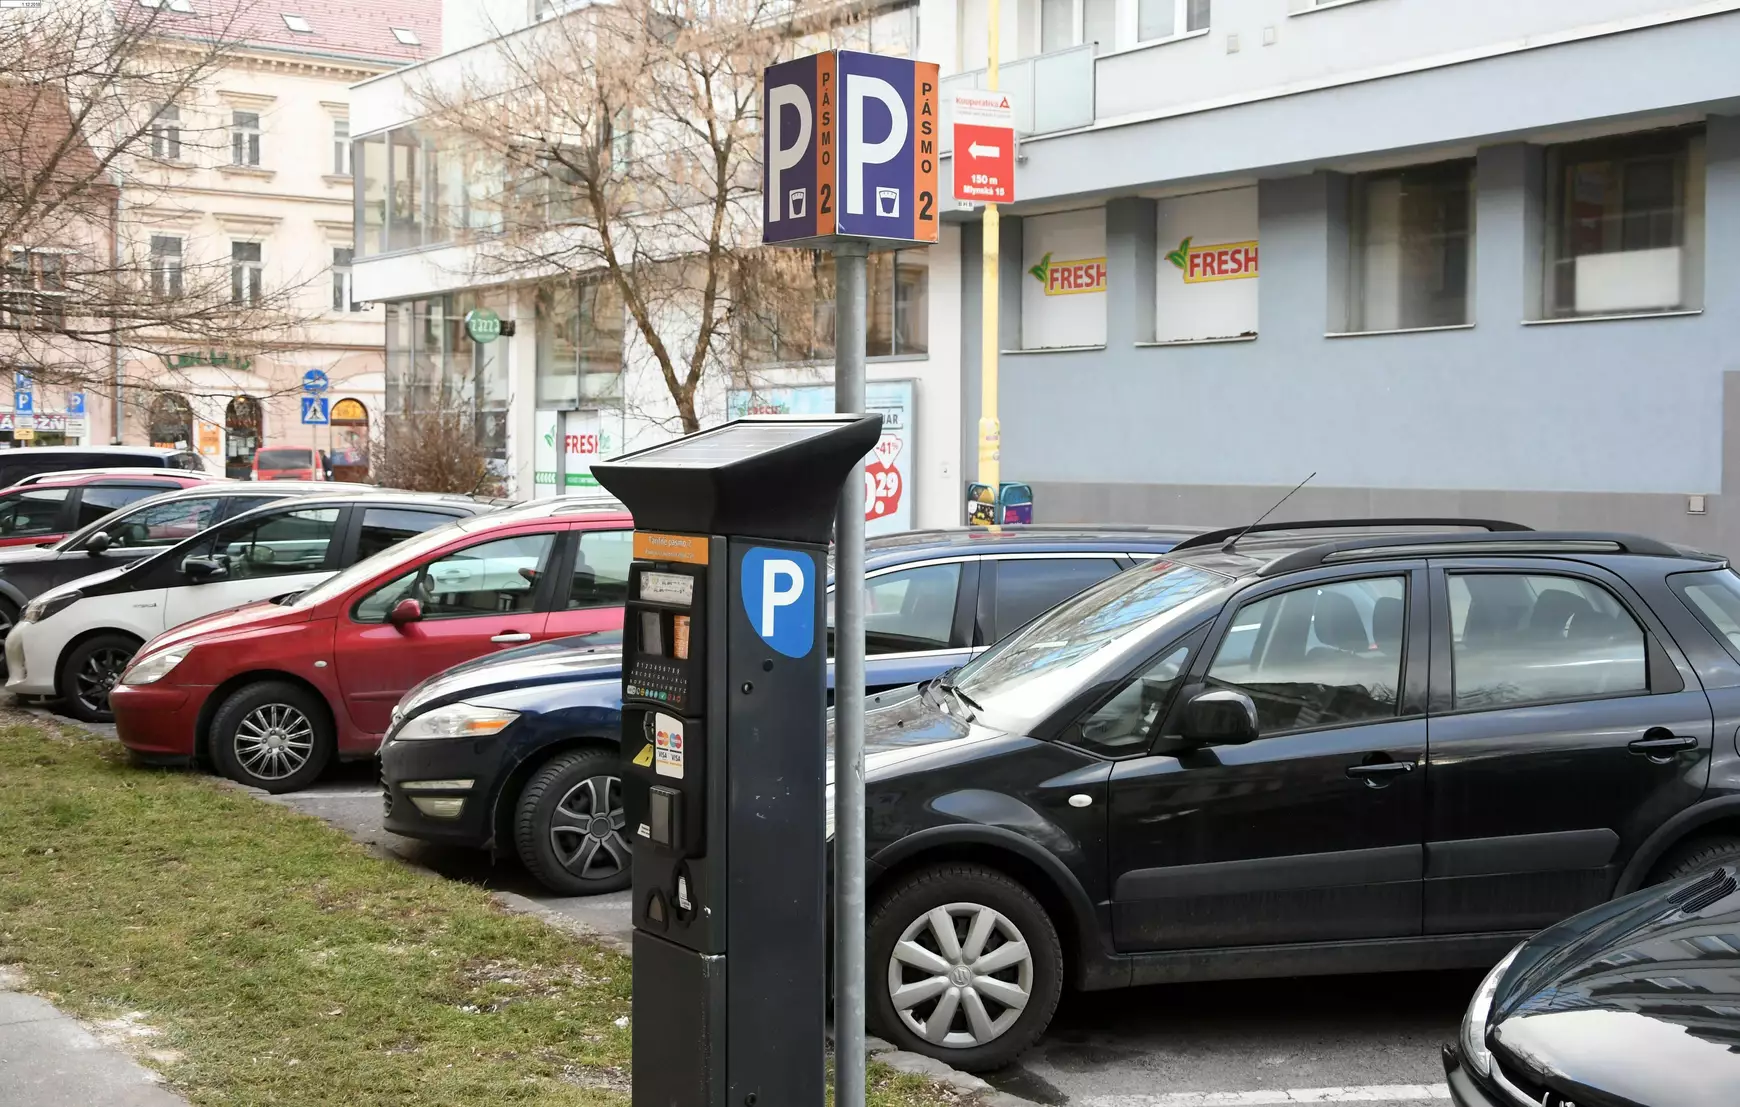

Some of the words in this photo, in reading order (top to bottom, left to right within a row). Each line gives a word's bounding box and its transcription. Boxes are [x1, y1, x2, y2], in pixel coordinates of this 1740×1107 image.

[822, 73, 831, 165] PÁSMO
[921, 83, 932, 173] PÁSMO
[769, 84, 812, 222] P
[847, 74, 908, 214] P
[971, 174, 988, 184] 150
[820, 184, 831, 214] 2
[919, 192, 933, 220] 2
[1189, 247, 1258, 277] FRESH
[1050, 265, 1107, 290] FRESH
[18, 393, 29, 409] P
[762, 560, 804, 637] P
